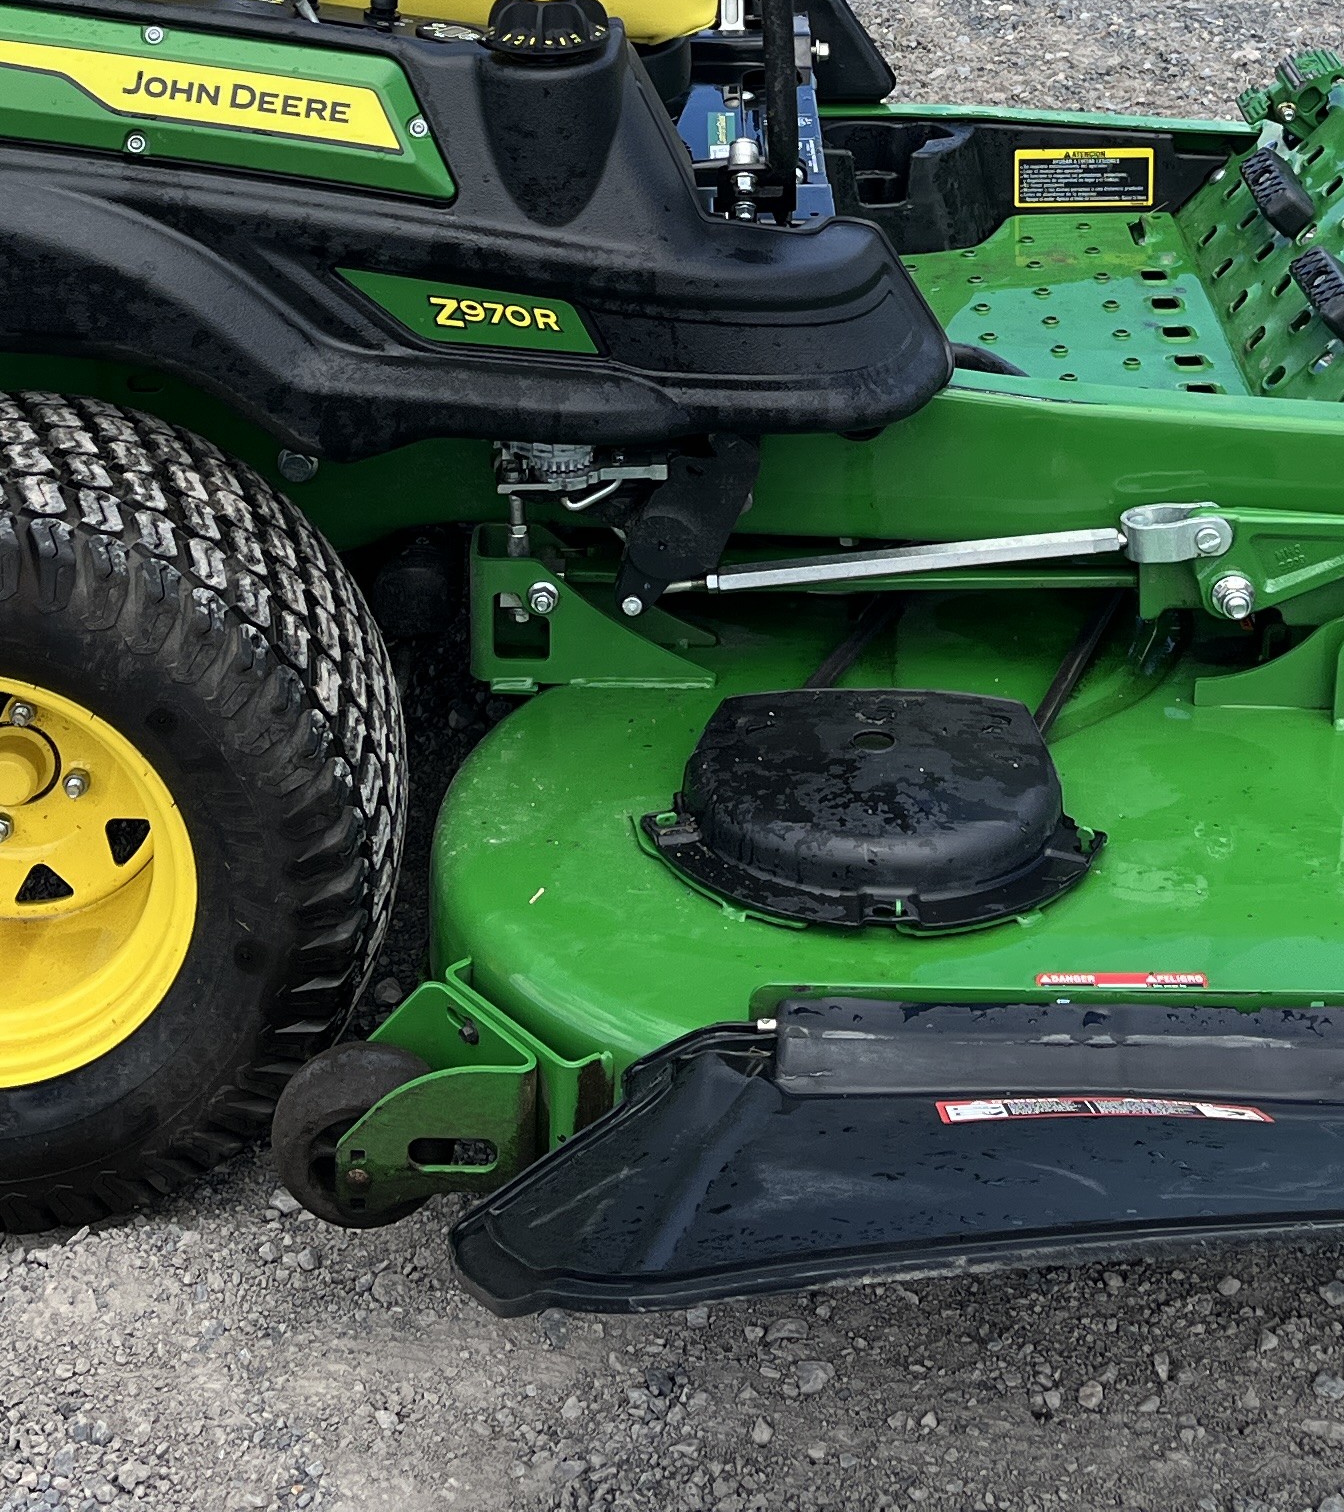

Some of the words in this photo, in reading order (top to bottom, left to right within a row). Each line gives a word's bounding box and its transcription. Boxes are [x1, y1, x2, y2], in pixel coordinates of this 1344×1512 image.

[122, 71, 221, 106] JOHN
[229, 83, 351, 123] DEERE
[428, 295, 562, 332] Z970R
[1050, 974, 1095, 983] DANGER
